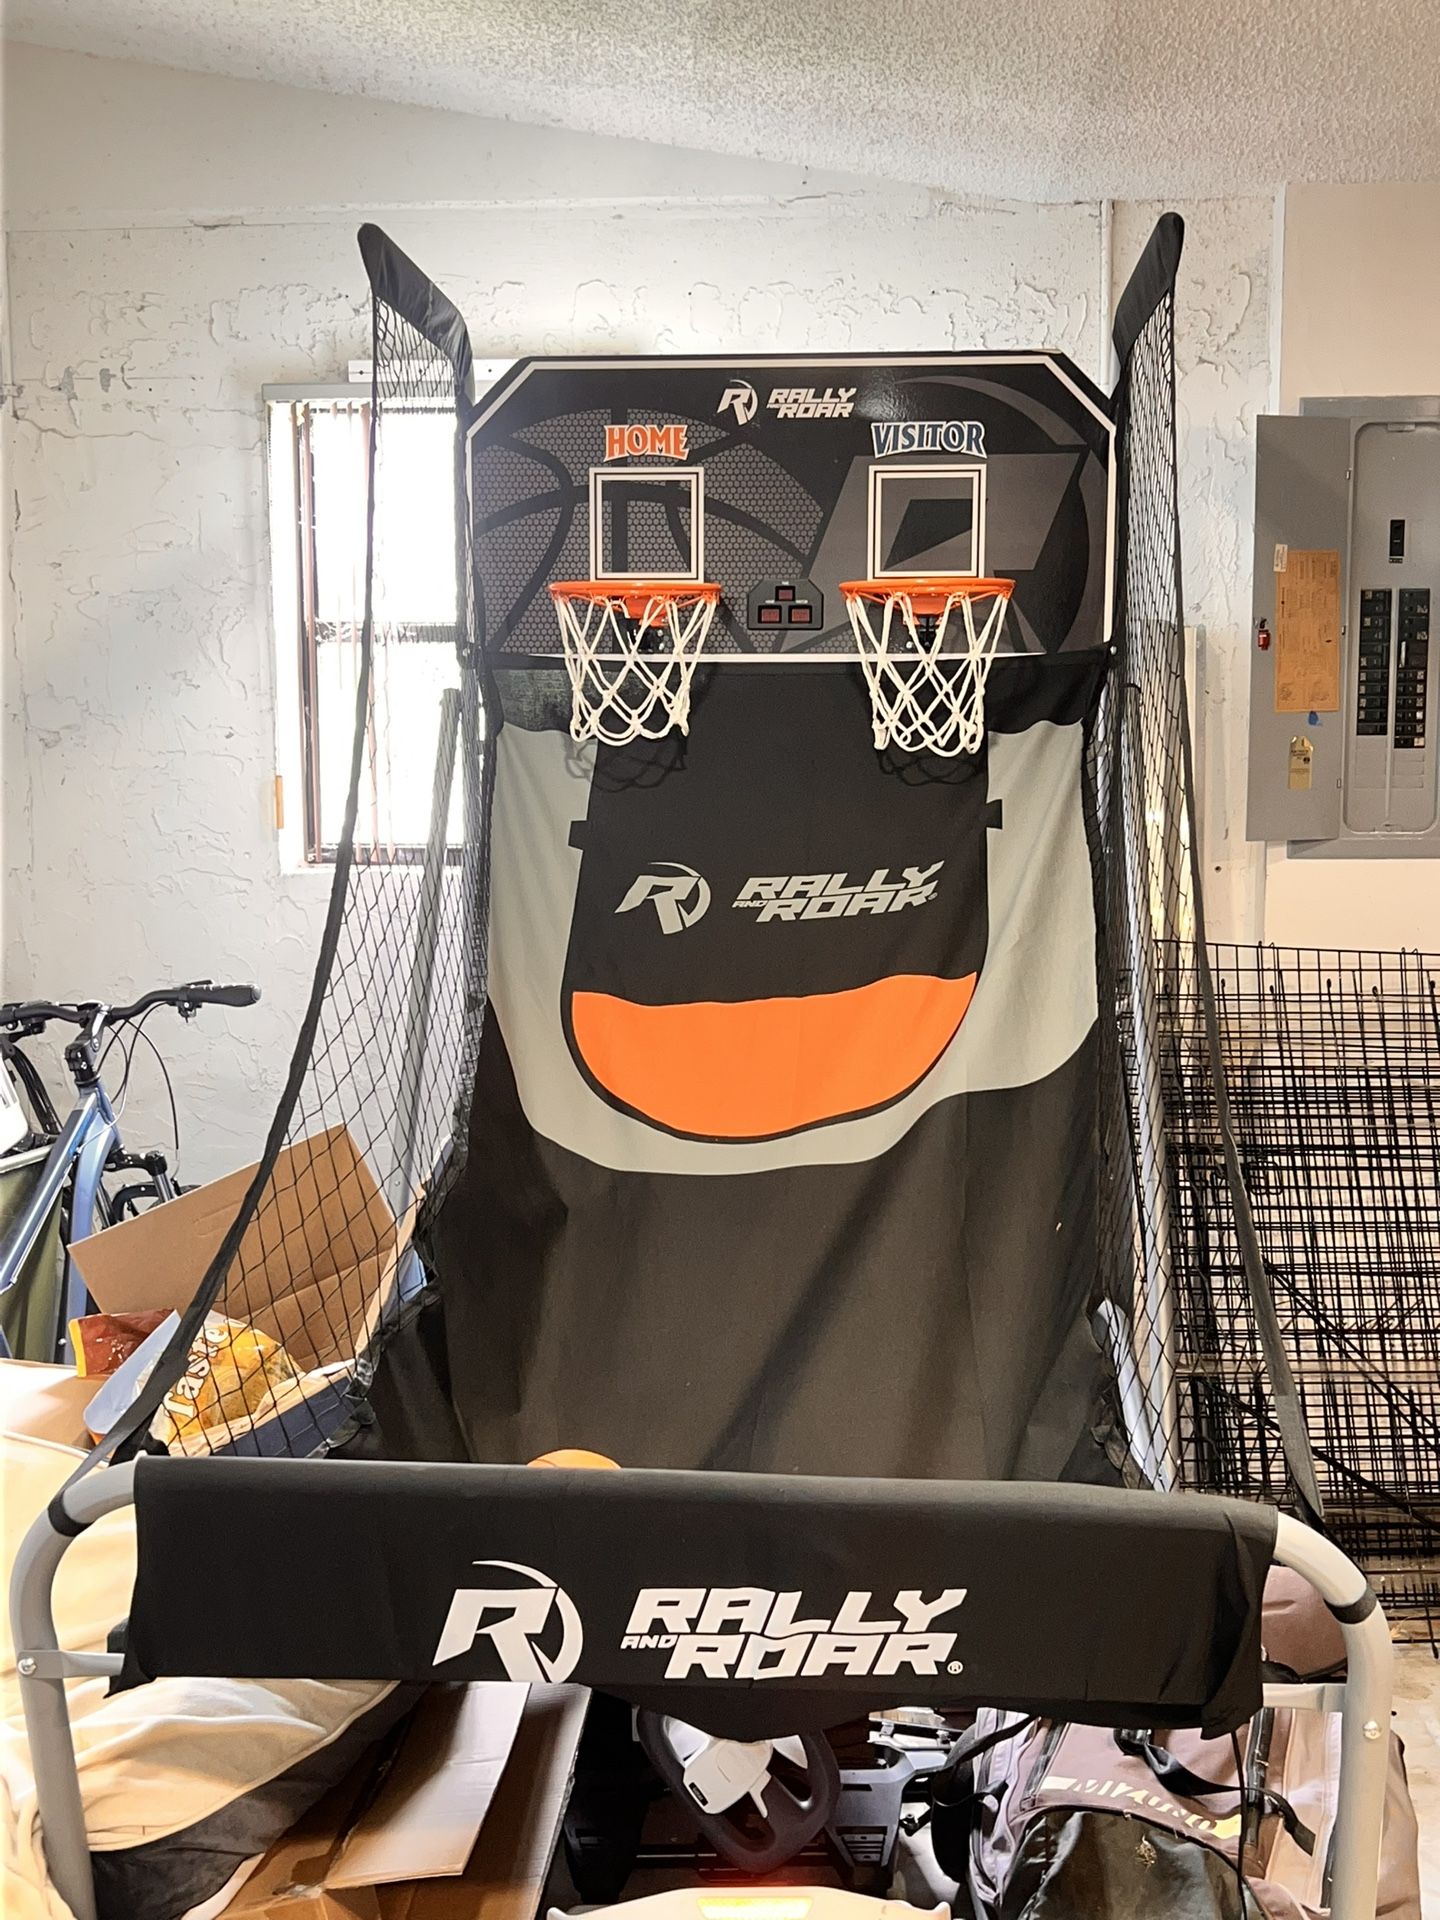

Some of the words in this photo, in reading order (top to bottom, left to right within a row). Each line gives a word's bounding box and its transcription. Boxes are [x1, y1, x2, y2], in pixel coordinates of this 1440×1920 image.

[767, 388, 857, 403] RALLY
[777, 402, 855, 419] ROAR
[603, 423, 689, 462] HOME
[871, 420, 988, 459] VISITOR
[736, 861, 945, 900] RALLY
[732, 899, 770, 909] AND
[755, 880, 938, 923] ROAR
[626, 1588, 967, 1634] RALLY
[620, 1634, 678, 1649] AND
